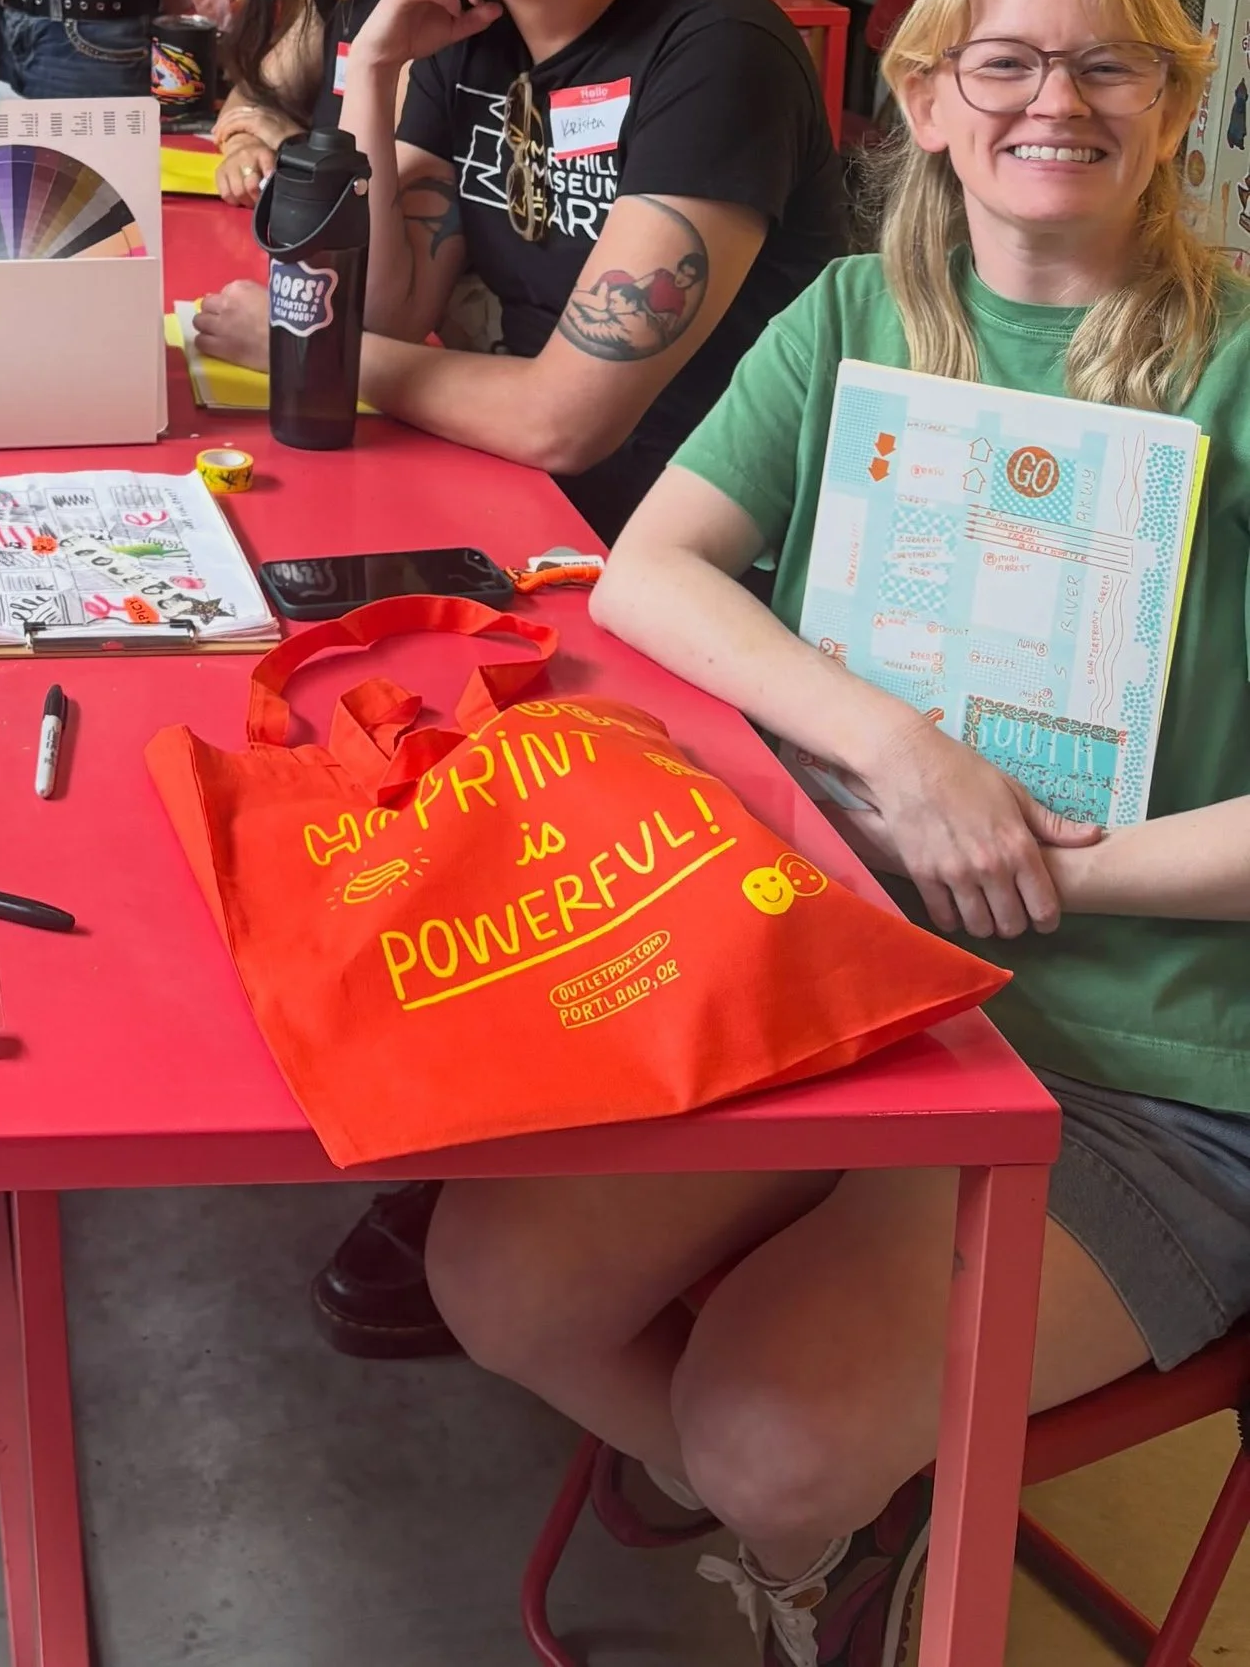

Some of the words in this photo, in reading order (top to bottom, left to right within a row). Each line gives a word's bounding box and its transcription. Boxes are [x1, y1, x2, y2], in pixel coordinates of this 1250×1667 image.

[272, 272, 325, 303] OOPS!
[276, 297, 308, 312] STARTED
[288, 310, 315, 322] HOBBY
[1015, 451, 1055, 494] GO
[1060, 575, 1081, 636] RIVER
[516, 821, 567, 866] is
[380, 788, 722, 1001] POWERFUL!
[559, 935, 664, 1001] OUTLETPDX.COM
[656, 958, 679, 981] OR
